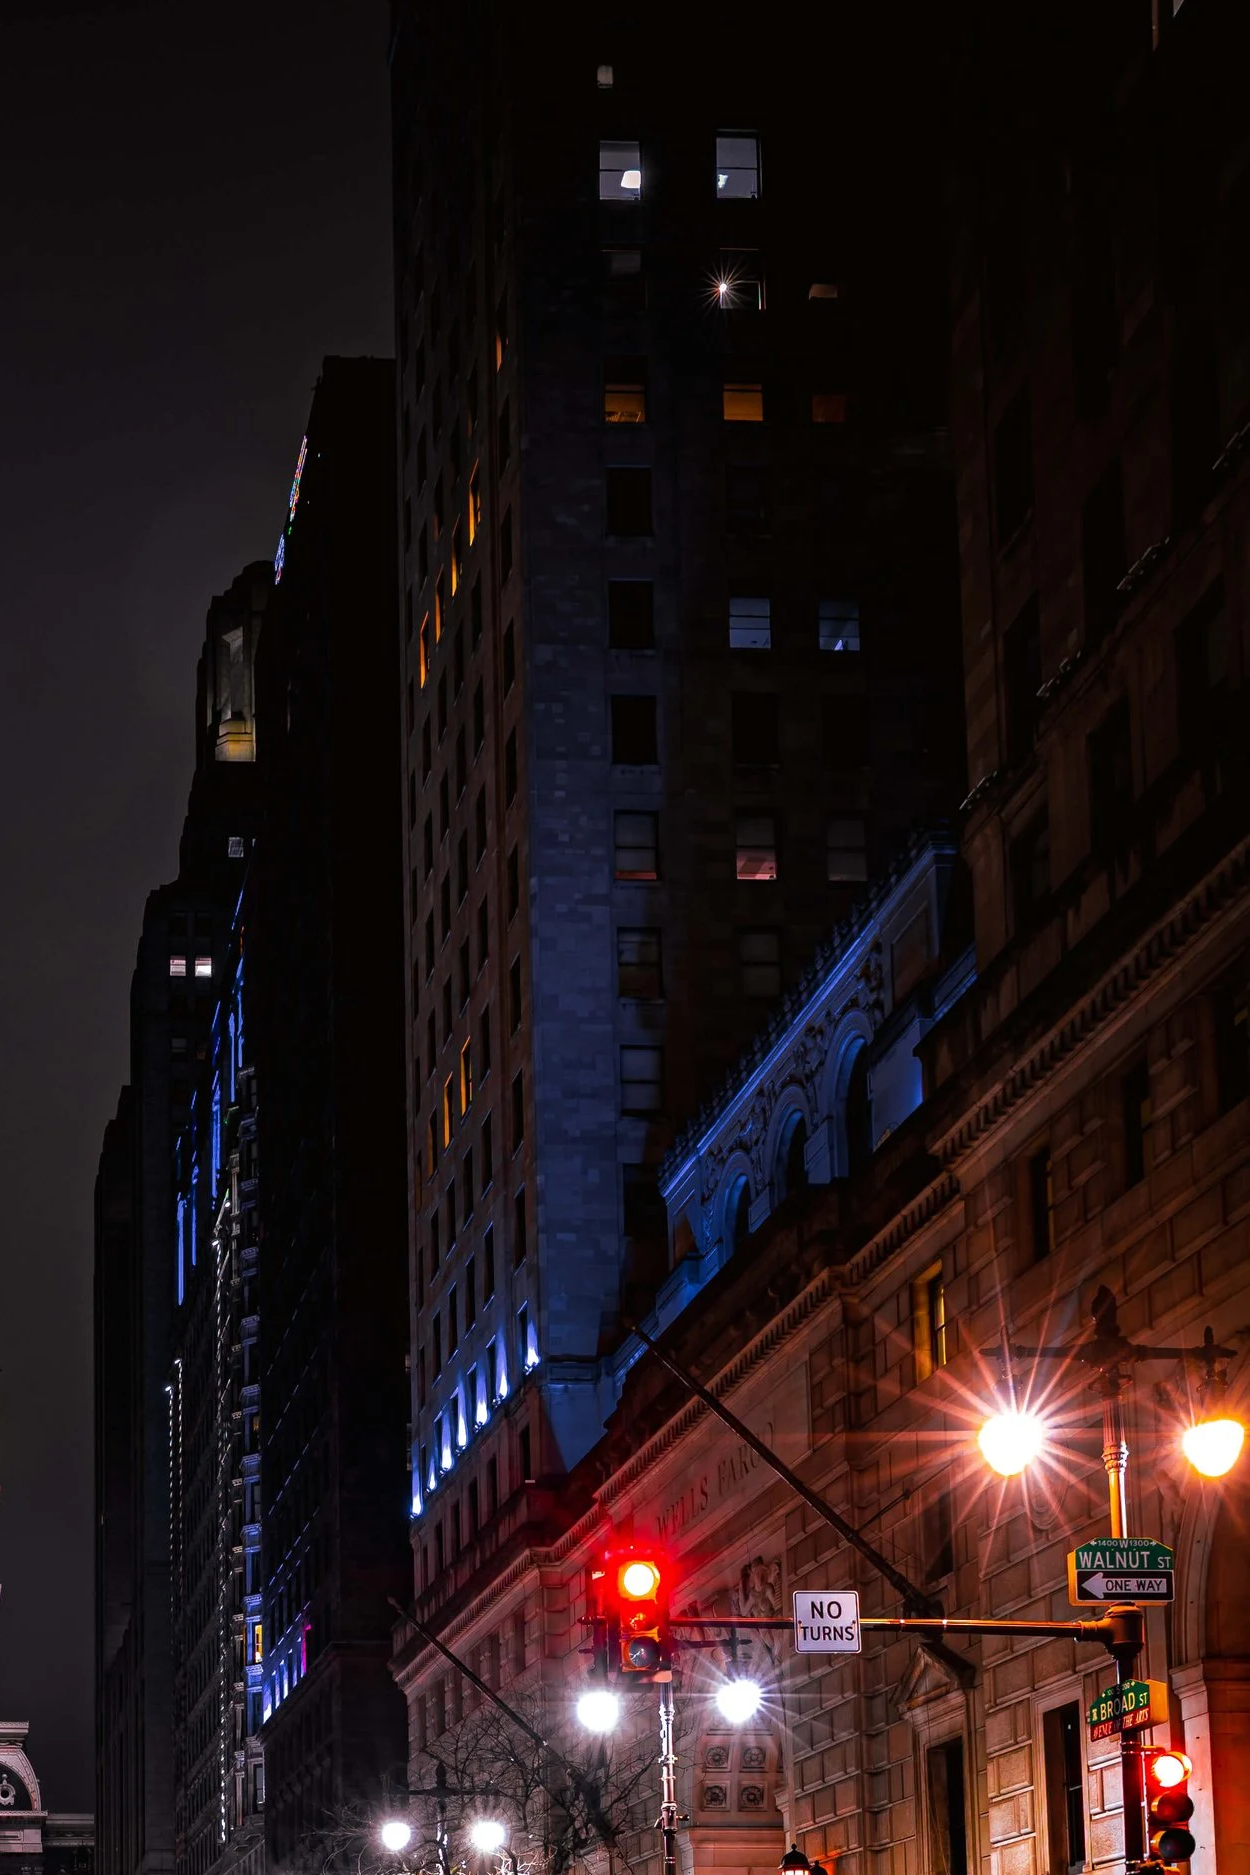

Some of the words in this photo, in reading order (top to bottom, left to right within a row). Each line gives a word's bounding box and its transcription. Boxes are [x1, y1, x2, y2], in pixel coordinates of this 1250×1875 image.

[654, 1475, 709, 1545] WELLS
[1120, 1540, 1128, 1549] W
[1078, 1551, 1150, 1569] WALNUT
[1157, 1556, 1171, 1569] ST
[1105, 1580, 1131, 1591] ONE
[1135, 1580, 1163, 1591] WAY
[811, 1601, 842, 1620] NO
[800, 1626, 855, 1641] TURNS
[1100, 1692, 1136, 1721] BROAD
[1139, 1692, 1148, 1706] ST
